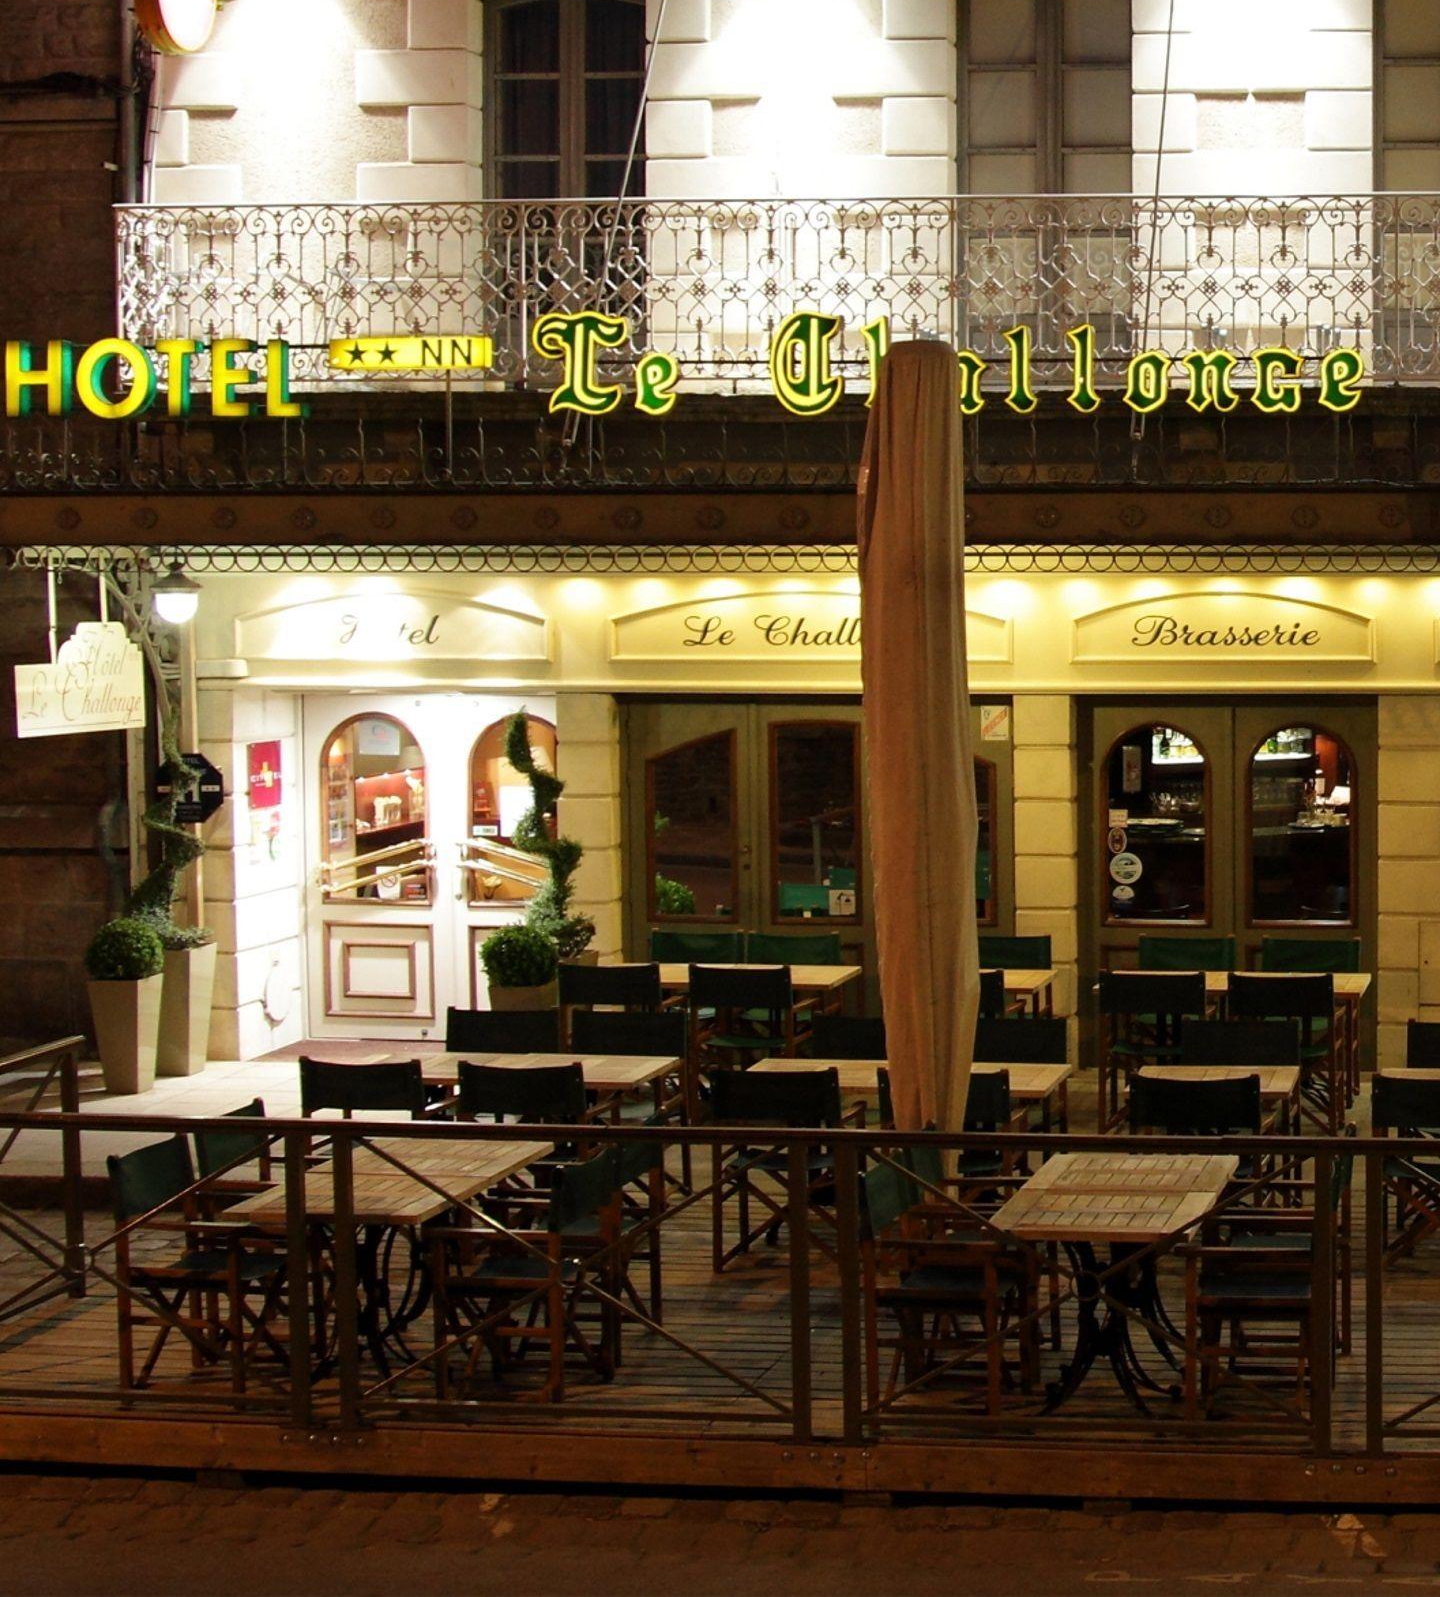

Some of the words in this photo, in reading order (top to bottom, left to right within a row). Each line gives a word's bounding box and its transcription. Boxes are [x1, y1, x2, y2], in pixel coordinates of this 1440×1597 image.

[421, 338, 473, 367] NN
[532, 311, 680, 415] Le
[5, 338, 307, 419] HOTEL
[683, 615, 736, 647] Le
[1131, 615, 1321, 647] Brasserie
